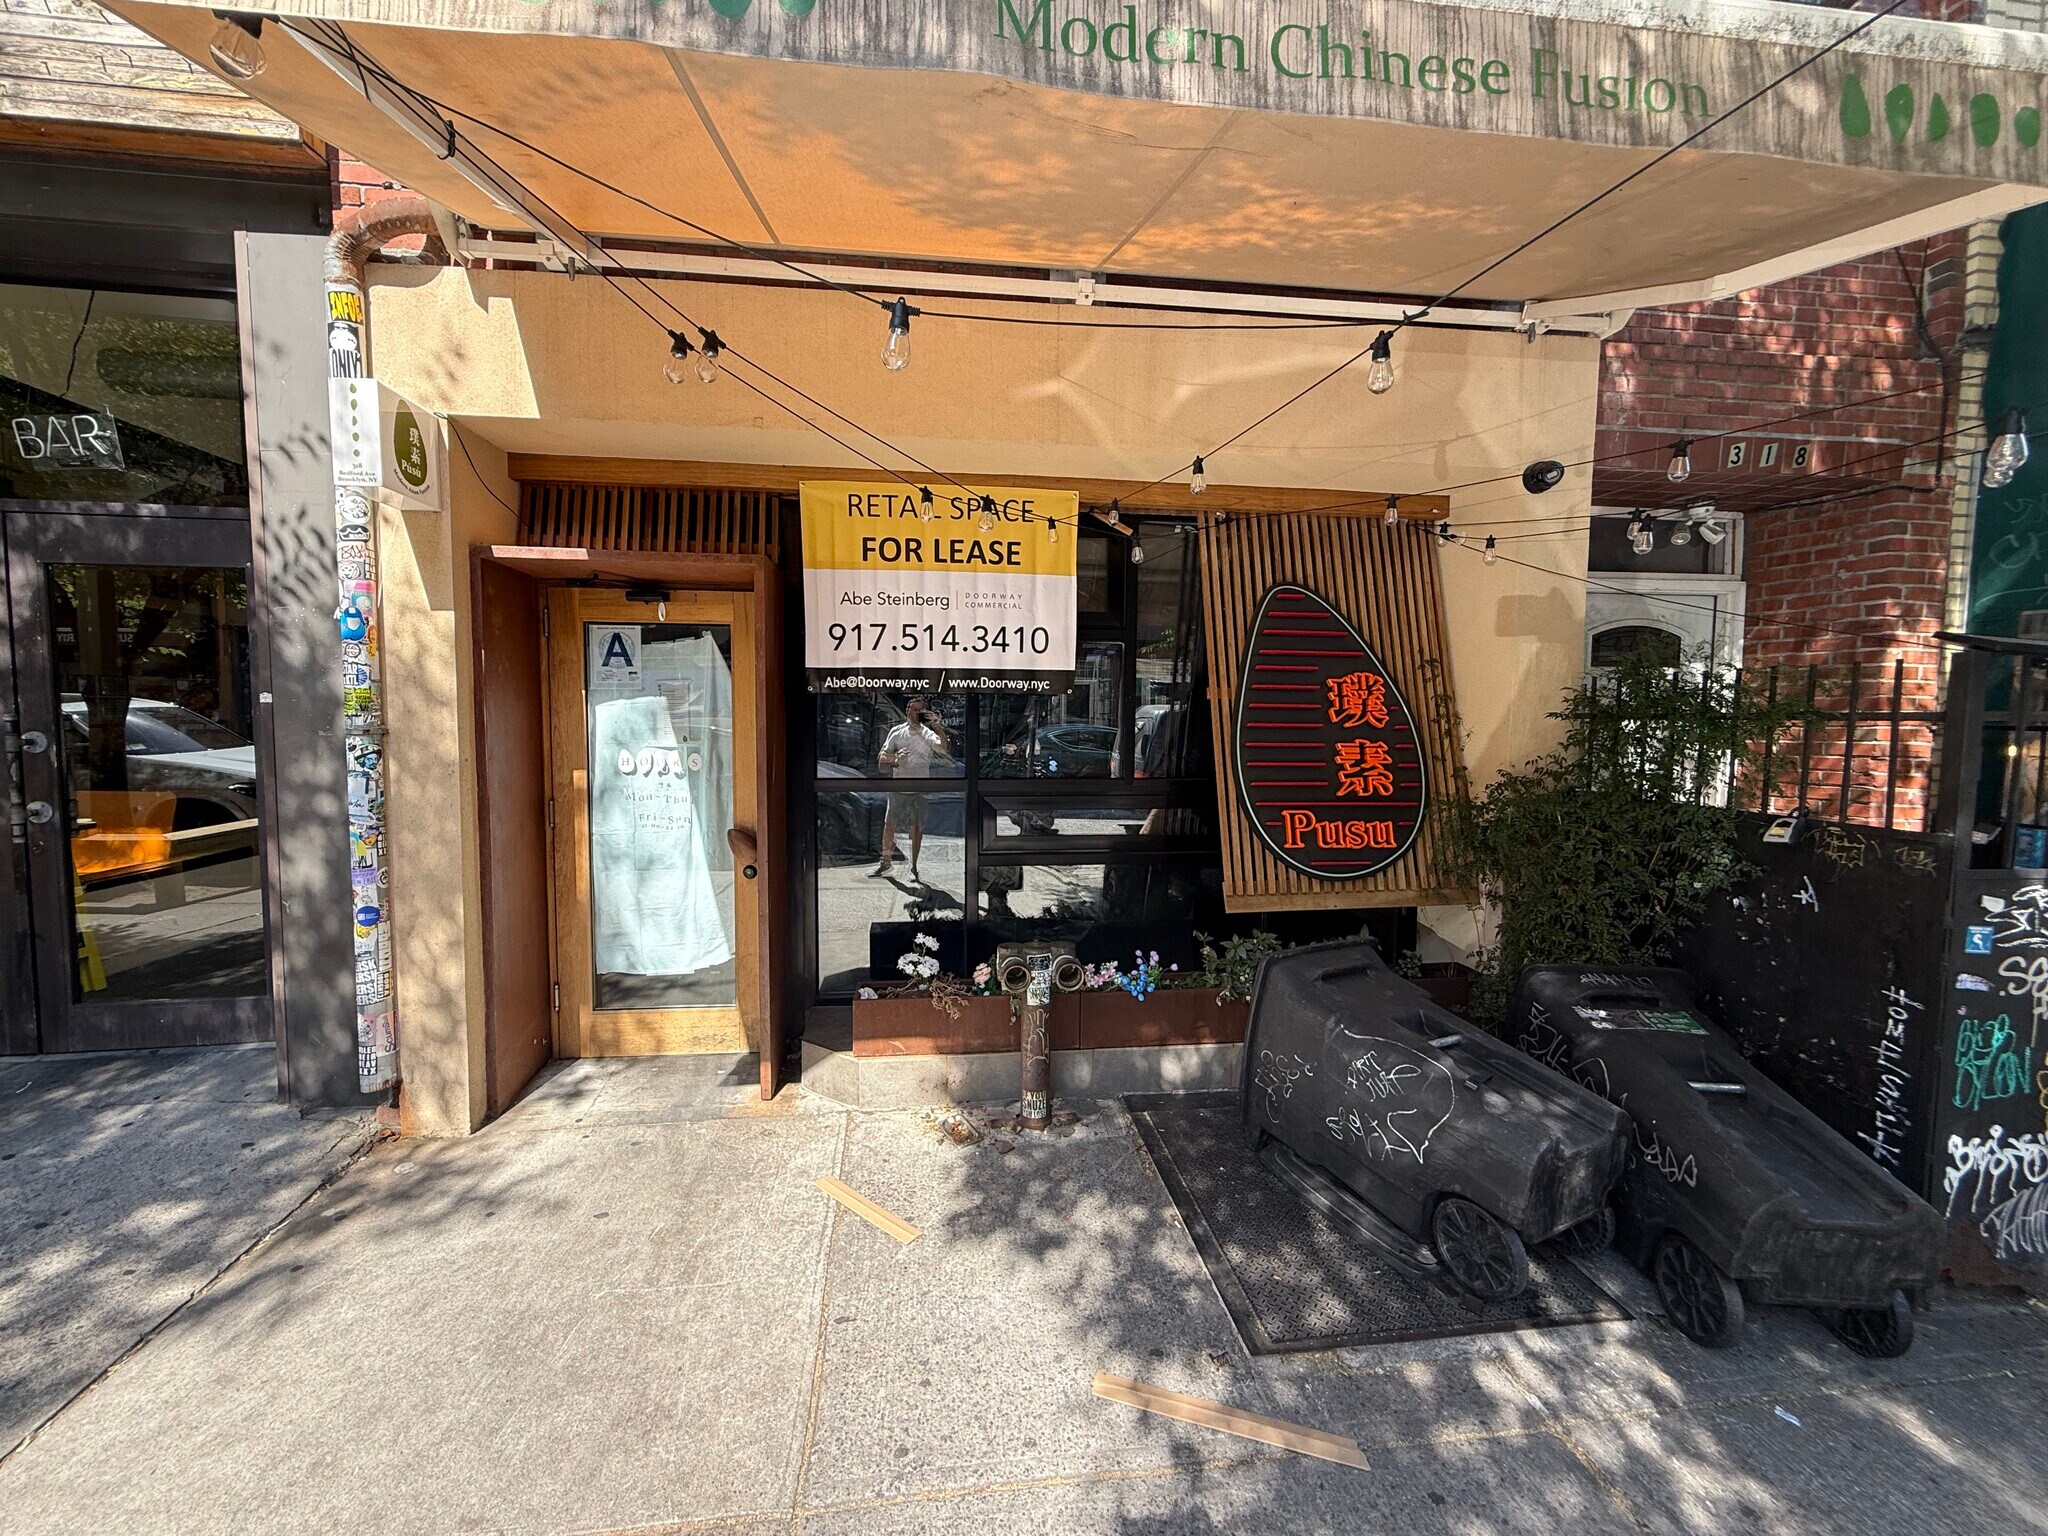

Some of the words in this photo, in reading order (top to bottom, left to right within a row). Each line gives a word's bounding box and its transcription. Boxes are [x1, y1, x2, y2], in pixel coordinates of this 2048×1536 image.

[993, 0, 1249, 72] Modern
[1270, 24, 1511, 95] Chinese
[1531, 47, 1713, 117] Fusion
[11, 415, 109, 459] BAR
[847, 493, 942, 519] RETAL
[861, 537, 923, 563] FOR
[933, 539, 1022, 566] LEASE
[840, 592, 872, 606] Abe
[877, 591, 950, 610] Steinberg
[964, 592, 1023, 601] DOORWAY
[964, 601, 1023, 610] COMMERCIAL
[601, 632, 634, 667] A
[828, 623, 1050, 654] 917.514.3410
[824, 676, 930, 690] Abe@Doorway.nyc
[948, 678, 1051, 690] www.Doorway.nyc
[1281, 809, 1397, 849] Pusu
